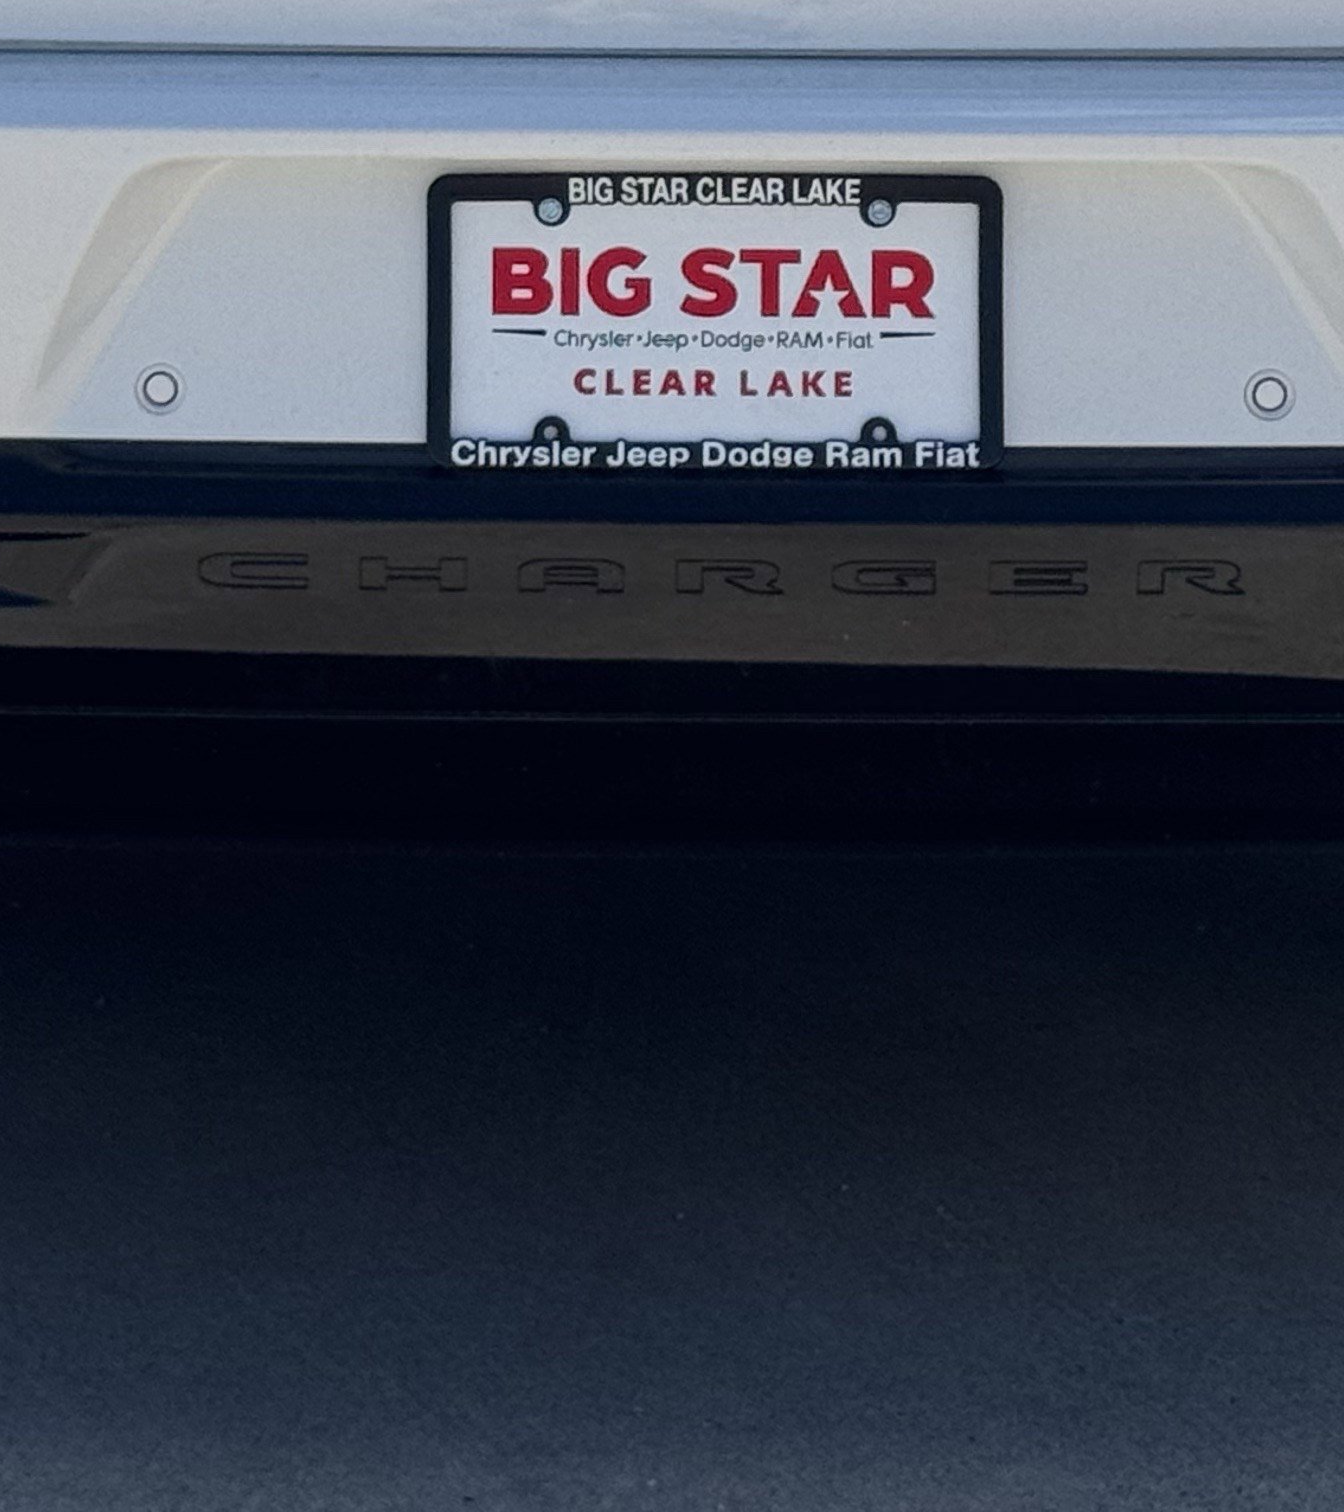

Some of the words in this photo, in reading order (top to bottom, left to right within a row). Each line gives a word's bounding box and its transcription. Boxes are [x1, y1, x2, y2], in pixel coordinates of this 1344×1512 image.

[567, 176, 614, 205] BIG
[620, 176, 689, 205] STAR
[695, 176, 785, 205] CLEAR
[792, 177, 862, 205] LAKE
[492, 247, 652, 317] BIG
[680, 248, 936, 319] STAR
[573, 368, 716, 396] CLEAR
[739, 370, 854, 397] LAKE
[451, 439, 594, 468] Chrysler
[605, 441, 691, 469] Jeep
[702, 440, 813, 469] Dodge
[825, 441, 904, 468] Ram
[914, 441, 980, 468] Fiat
[197, 551, 1246, 597] CHARGER
